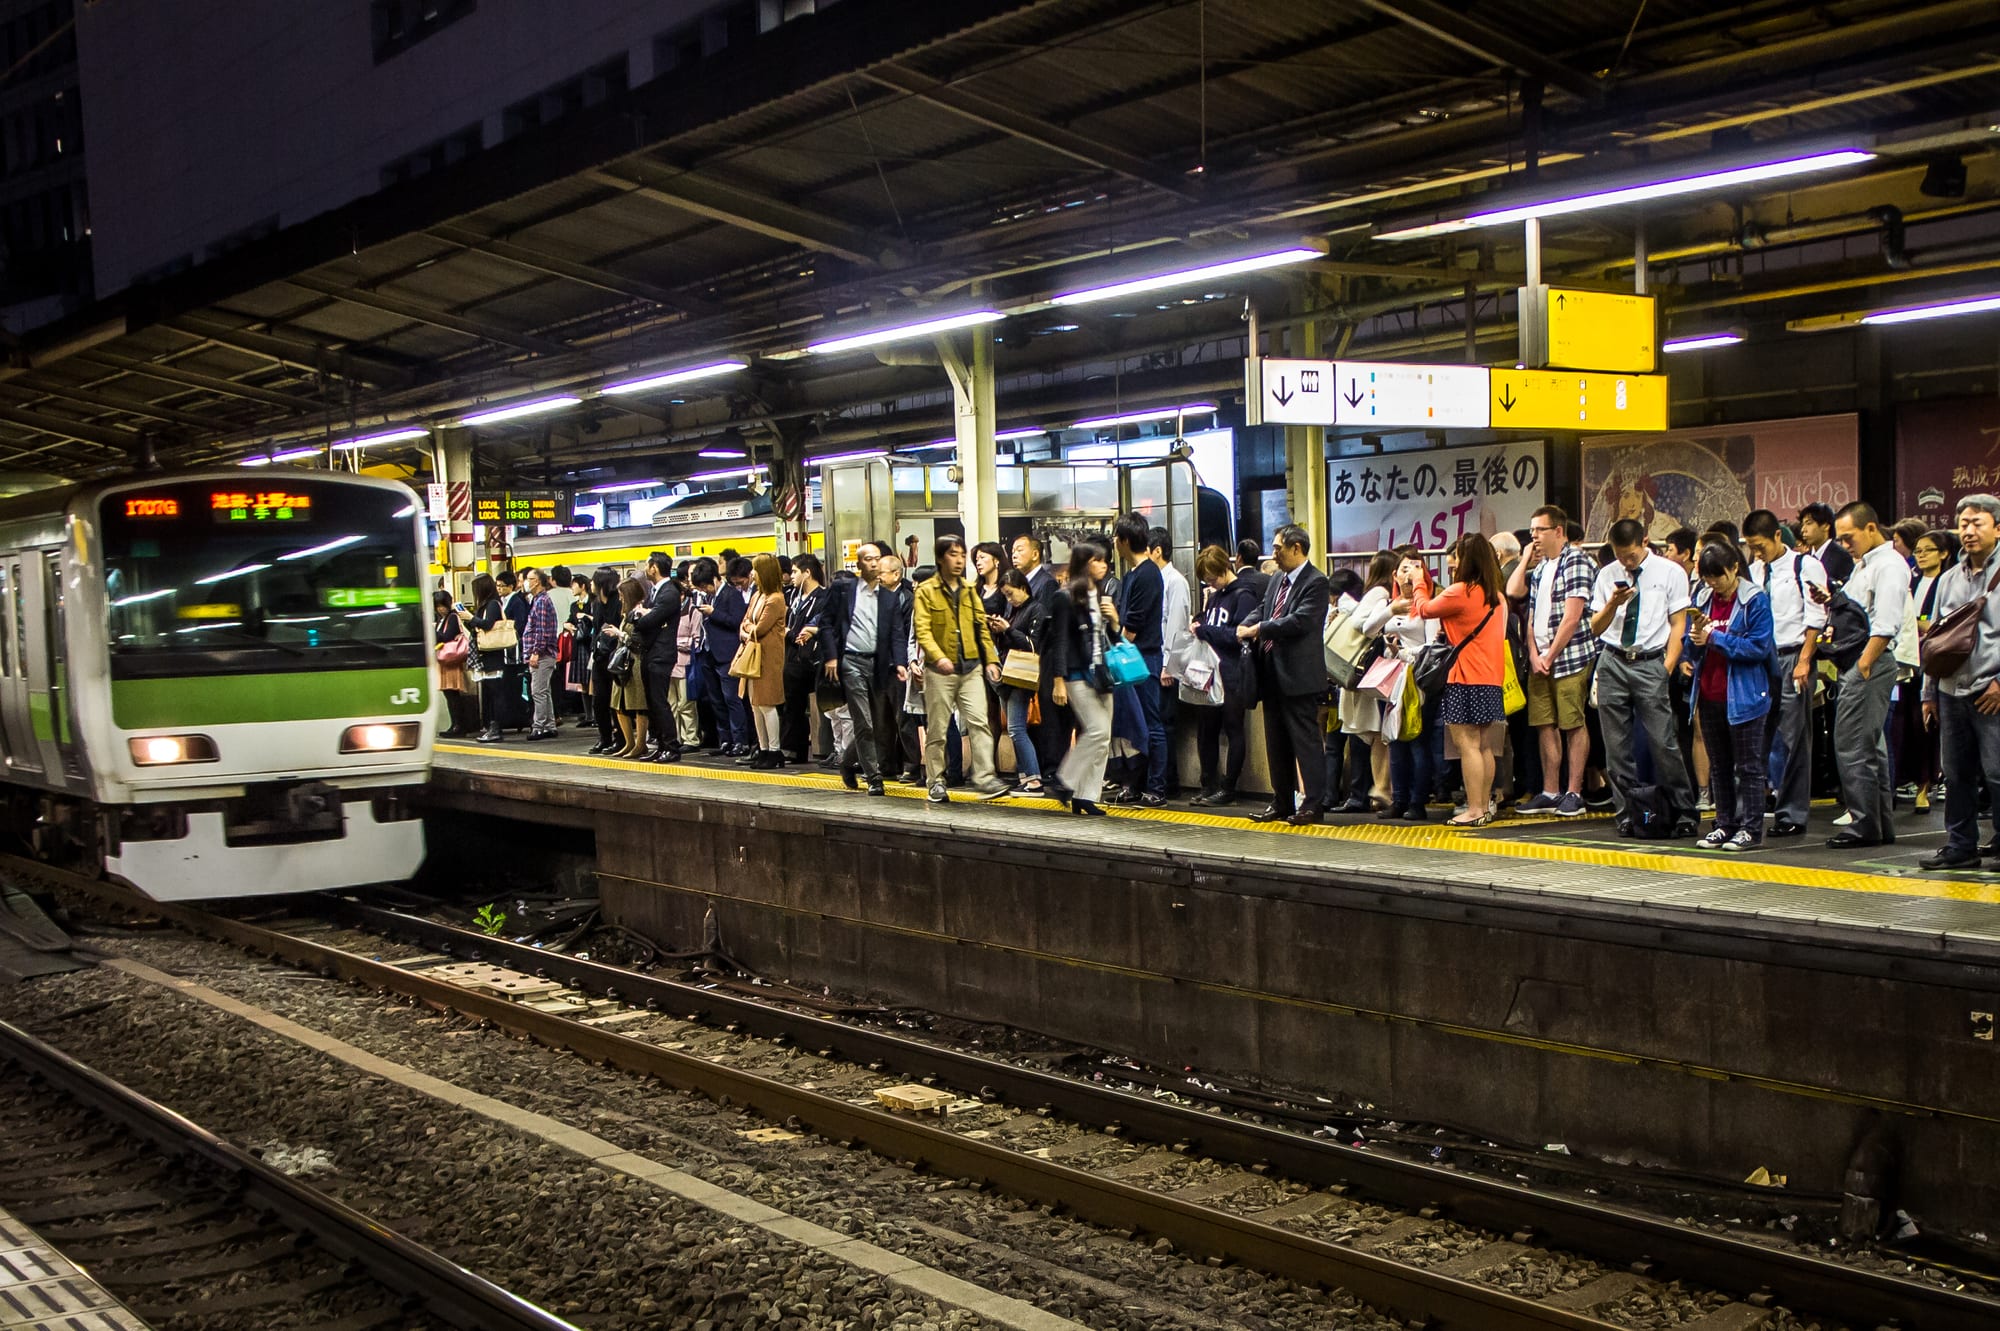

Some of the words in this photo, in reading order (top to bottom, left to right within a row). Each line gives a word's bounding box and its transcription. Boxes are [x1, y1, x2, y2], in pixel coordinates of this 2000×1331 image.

[1335, 454, 1539, 504] あなたの、最後の
[554, 490, 565, 500] 16
[1762, 467, 1850, 509] Mucha
[125, 500, 178, 516] 1707G
[478, 501, 500, 510] LOCAL
[505, 500, 529, 509] 18:55
[478, 511, 501, 520] LOCAL
[505, 511, 529, 519] 19:00
[1388, 499, 1474, 550] LAST
[1206, 607, 1229, 627] AP
[390, 687, 421, 704] JR
